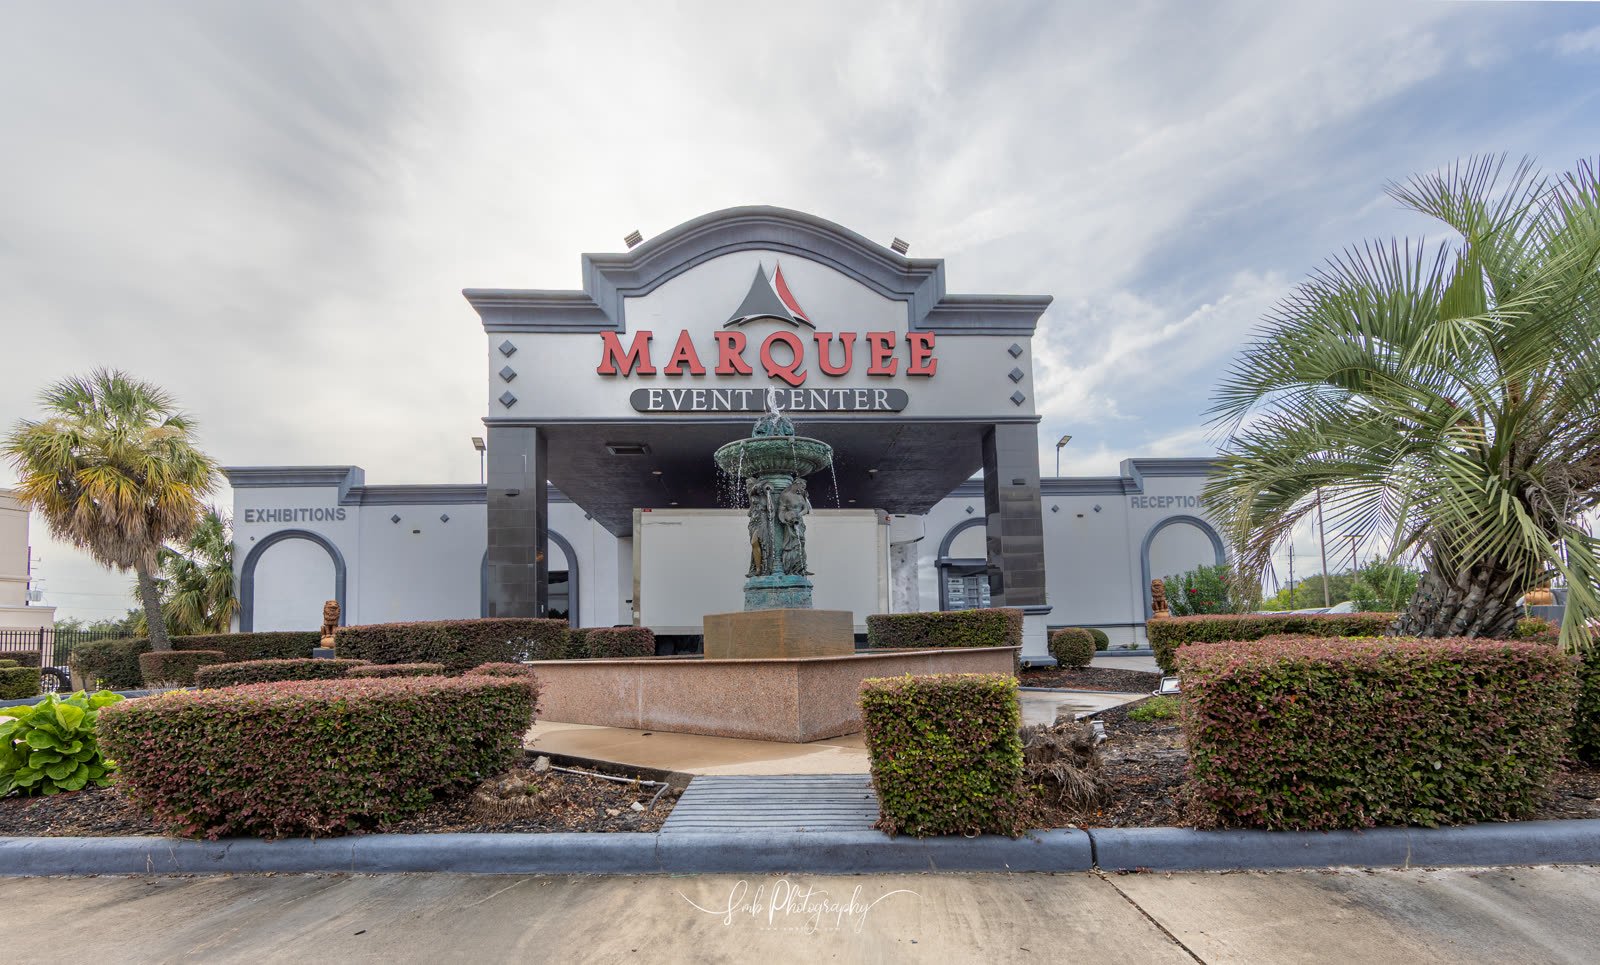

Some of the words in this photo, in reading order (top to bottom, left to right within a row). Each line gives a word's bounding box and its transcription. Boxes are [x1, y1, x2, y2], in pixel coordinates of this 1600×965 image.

[597, 329, 938, 388] MARQUEE
[647, 388, 753, 411] EVENT
[766, 388, 892, 411] CENTER
[244, 507, 347, 523] EXHIBITIONS
